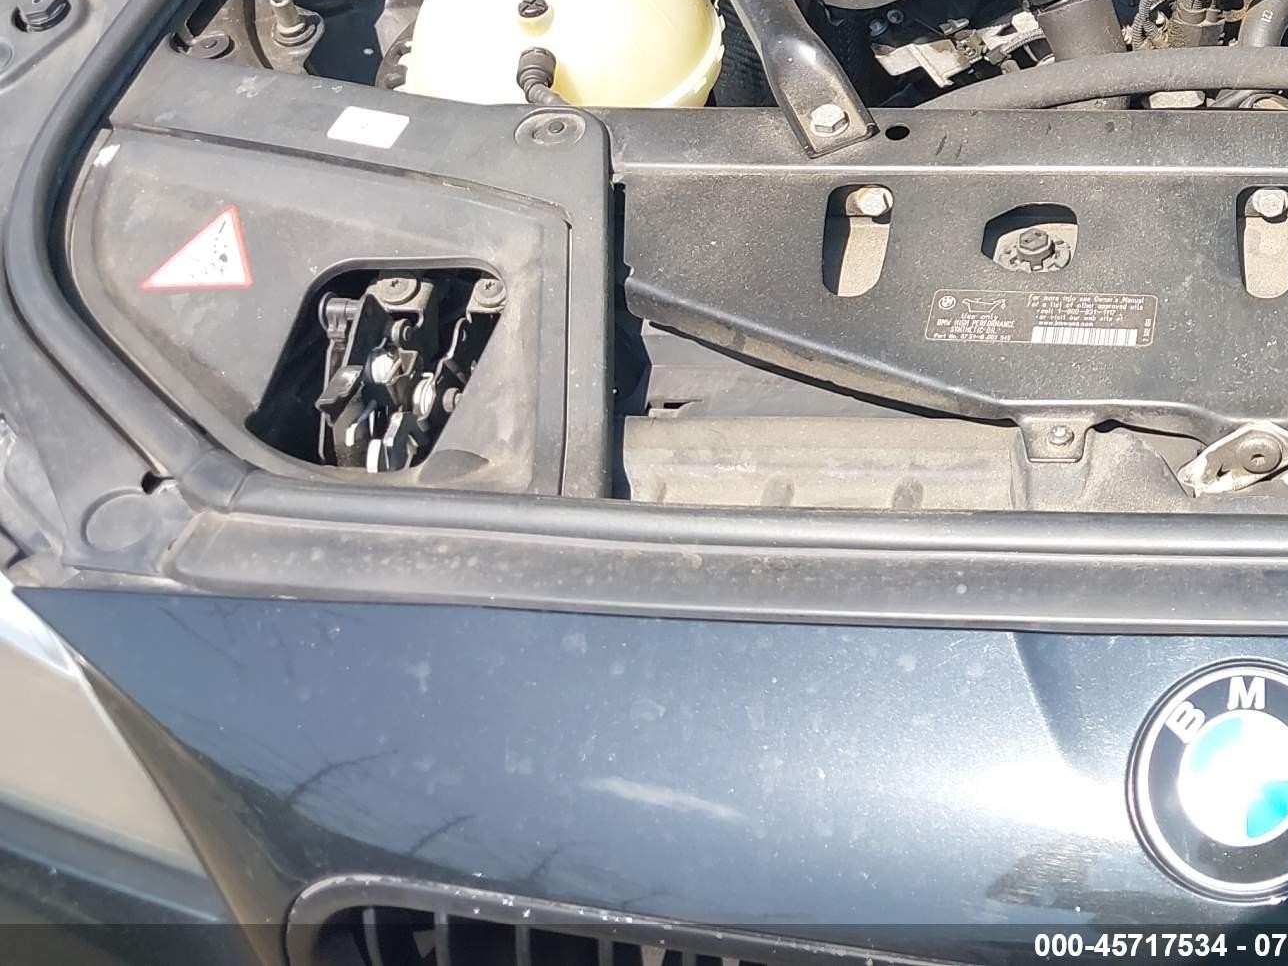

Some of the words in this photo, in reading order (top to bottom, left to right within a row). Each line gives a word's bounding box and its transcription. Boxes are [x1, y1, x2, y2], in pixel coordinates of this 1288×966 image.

[1028, 294, 1041, 302] For
[1027, 299, 1041, 307] For
[980, 313, 999, 321] only
[971, 319, 1016, 328] PERFORMANCE
[950, 325, 985, 333] SYNTHETIC
